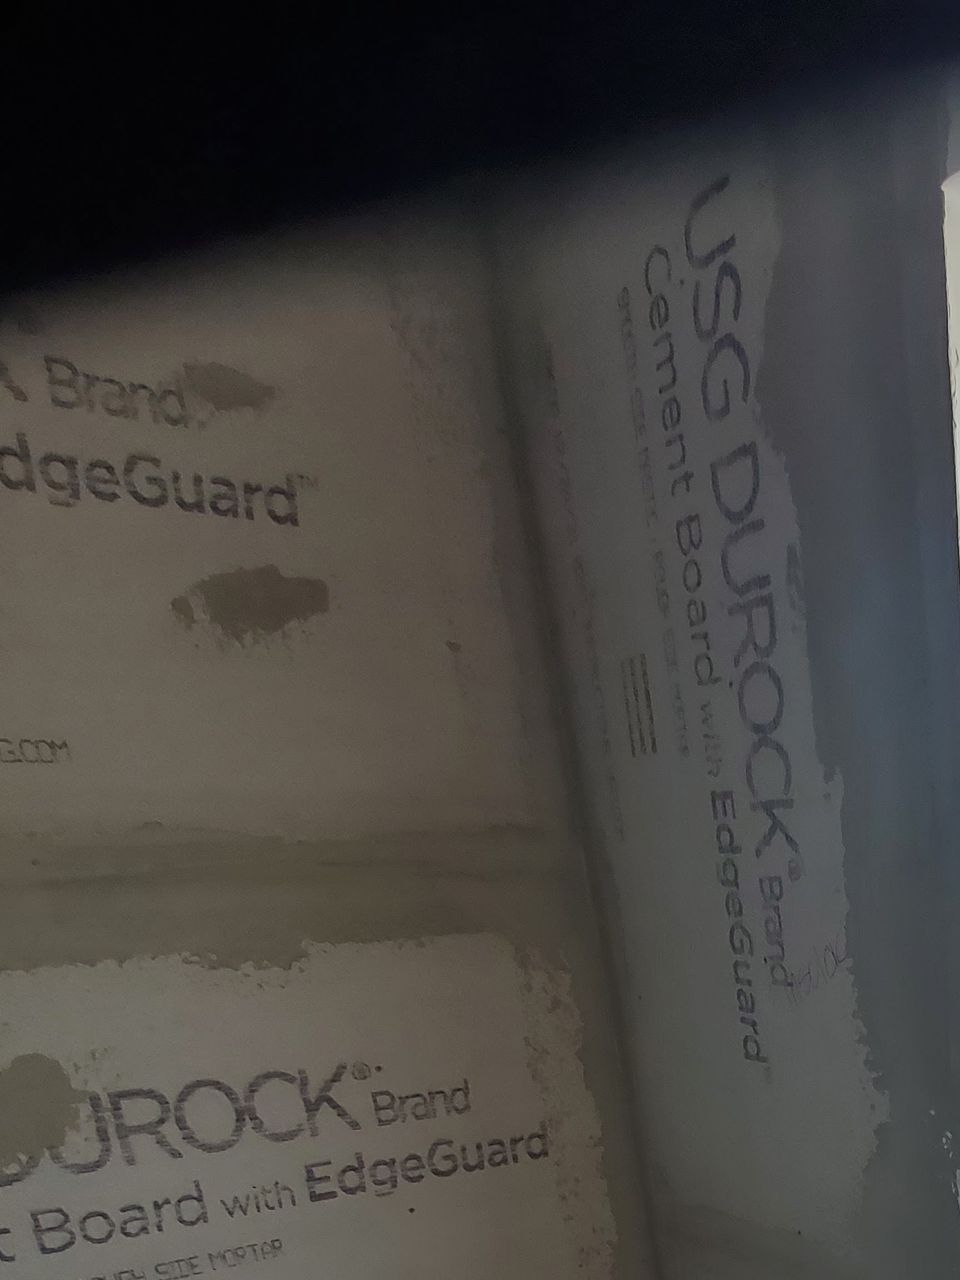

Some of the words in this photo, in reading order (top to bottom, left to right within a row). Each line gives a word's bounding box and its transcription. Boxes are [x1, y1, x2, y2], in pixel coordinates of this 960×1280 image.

[645, 245, 694, 497] Cement
[676, 513, 721, 688] Board
[700, 702, 722, 778] with
[711, 790, 769, 1064] EdgeGuard
[684, 174, 751, 422] USG
[758, 875, 793, 987] Brand
[30, 1180, 209, 1256] Board
[221, 1181, 297, 1219] with
[305, 1121, 550, 1203] EdgeGuard
[372, 1079, 471, 1126] Brand
